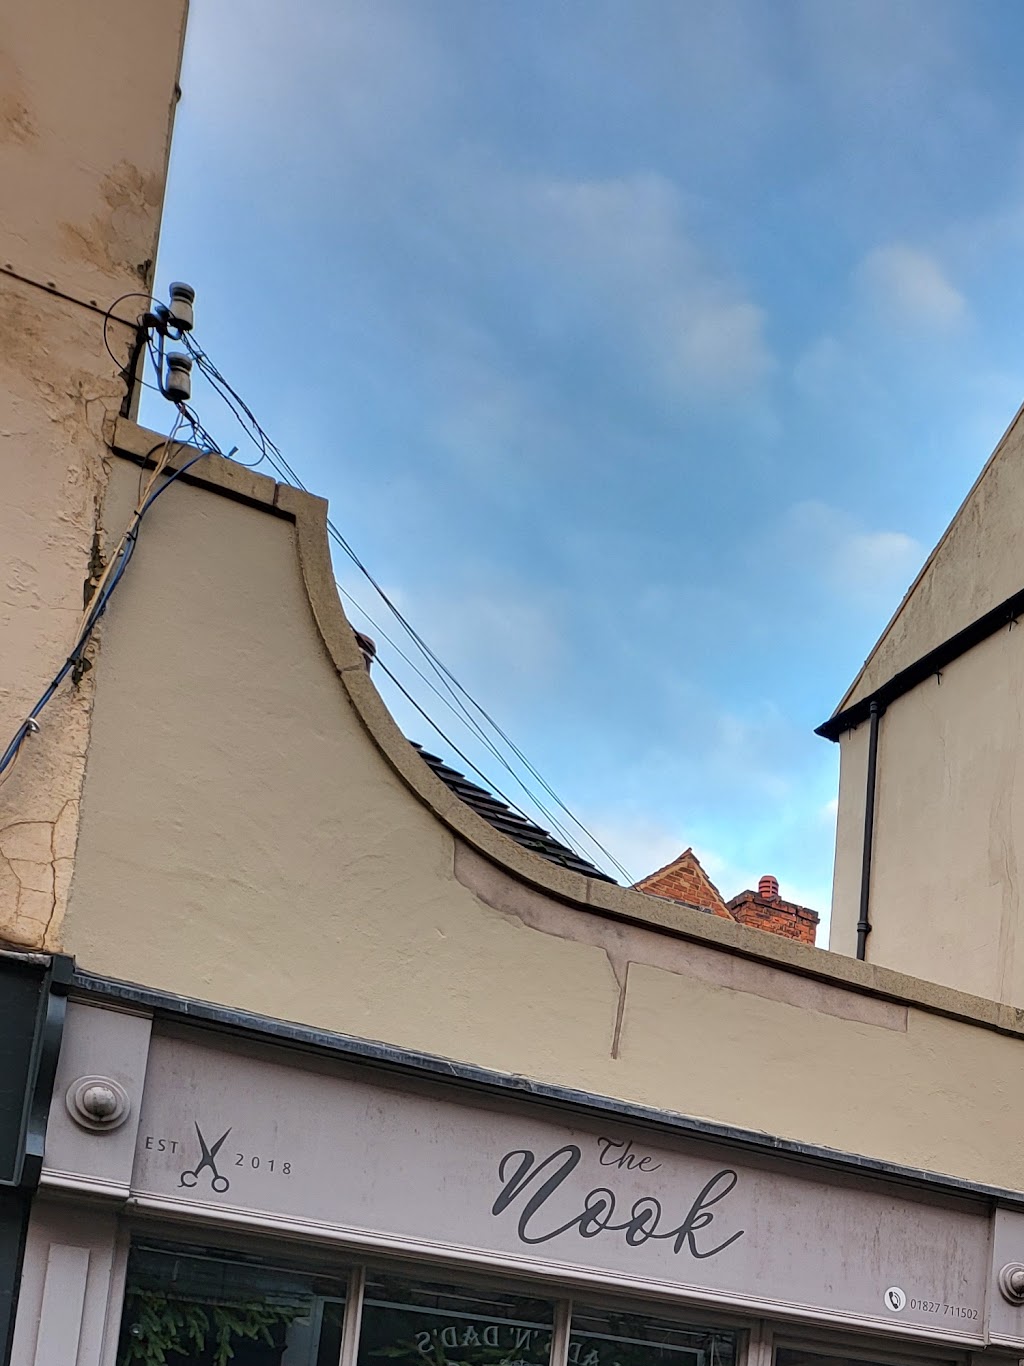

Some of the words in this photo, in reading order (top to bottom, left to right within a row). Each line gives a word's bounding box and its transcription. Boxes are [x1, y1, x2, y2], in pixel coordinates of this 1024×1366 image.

[145, 1136, 179, 1154] EST
[235, 1153, 292, 1175] 2018
[597, 1137, 662, 1173] The
[492, 1144, 745, 1259] Nook
[910, 1298, 941, 1314] 01827
[943, 1304, 979, 1321] 711502
